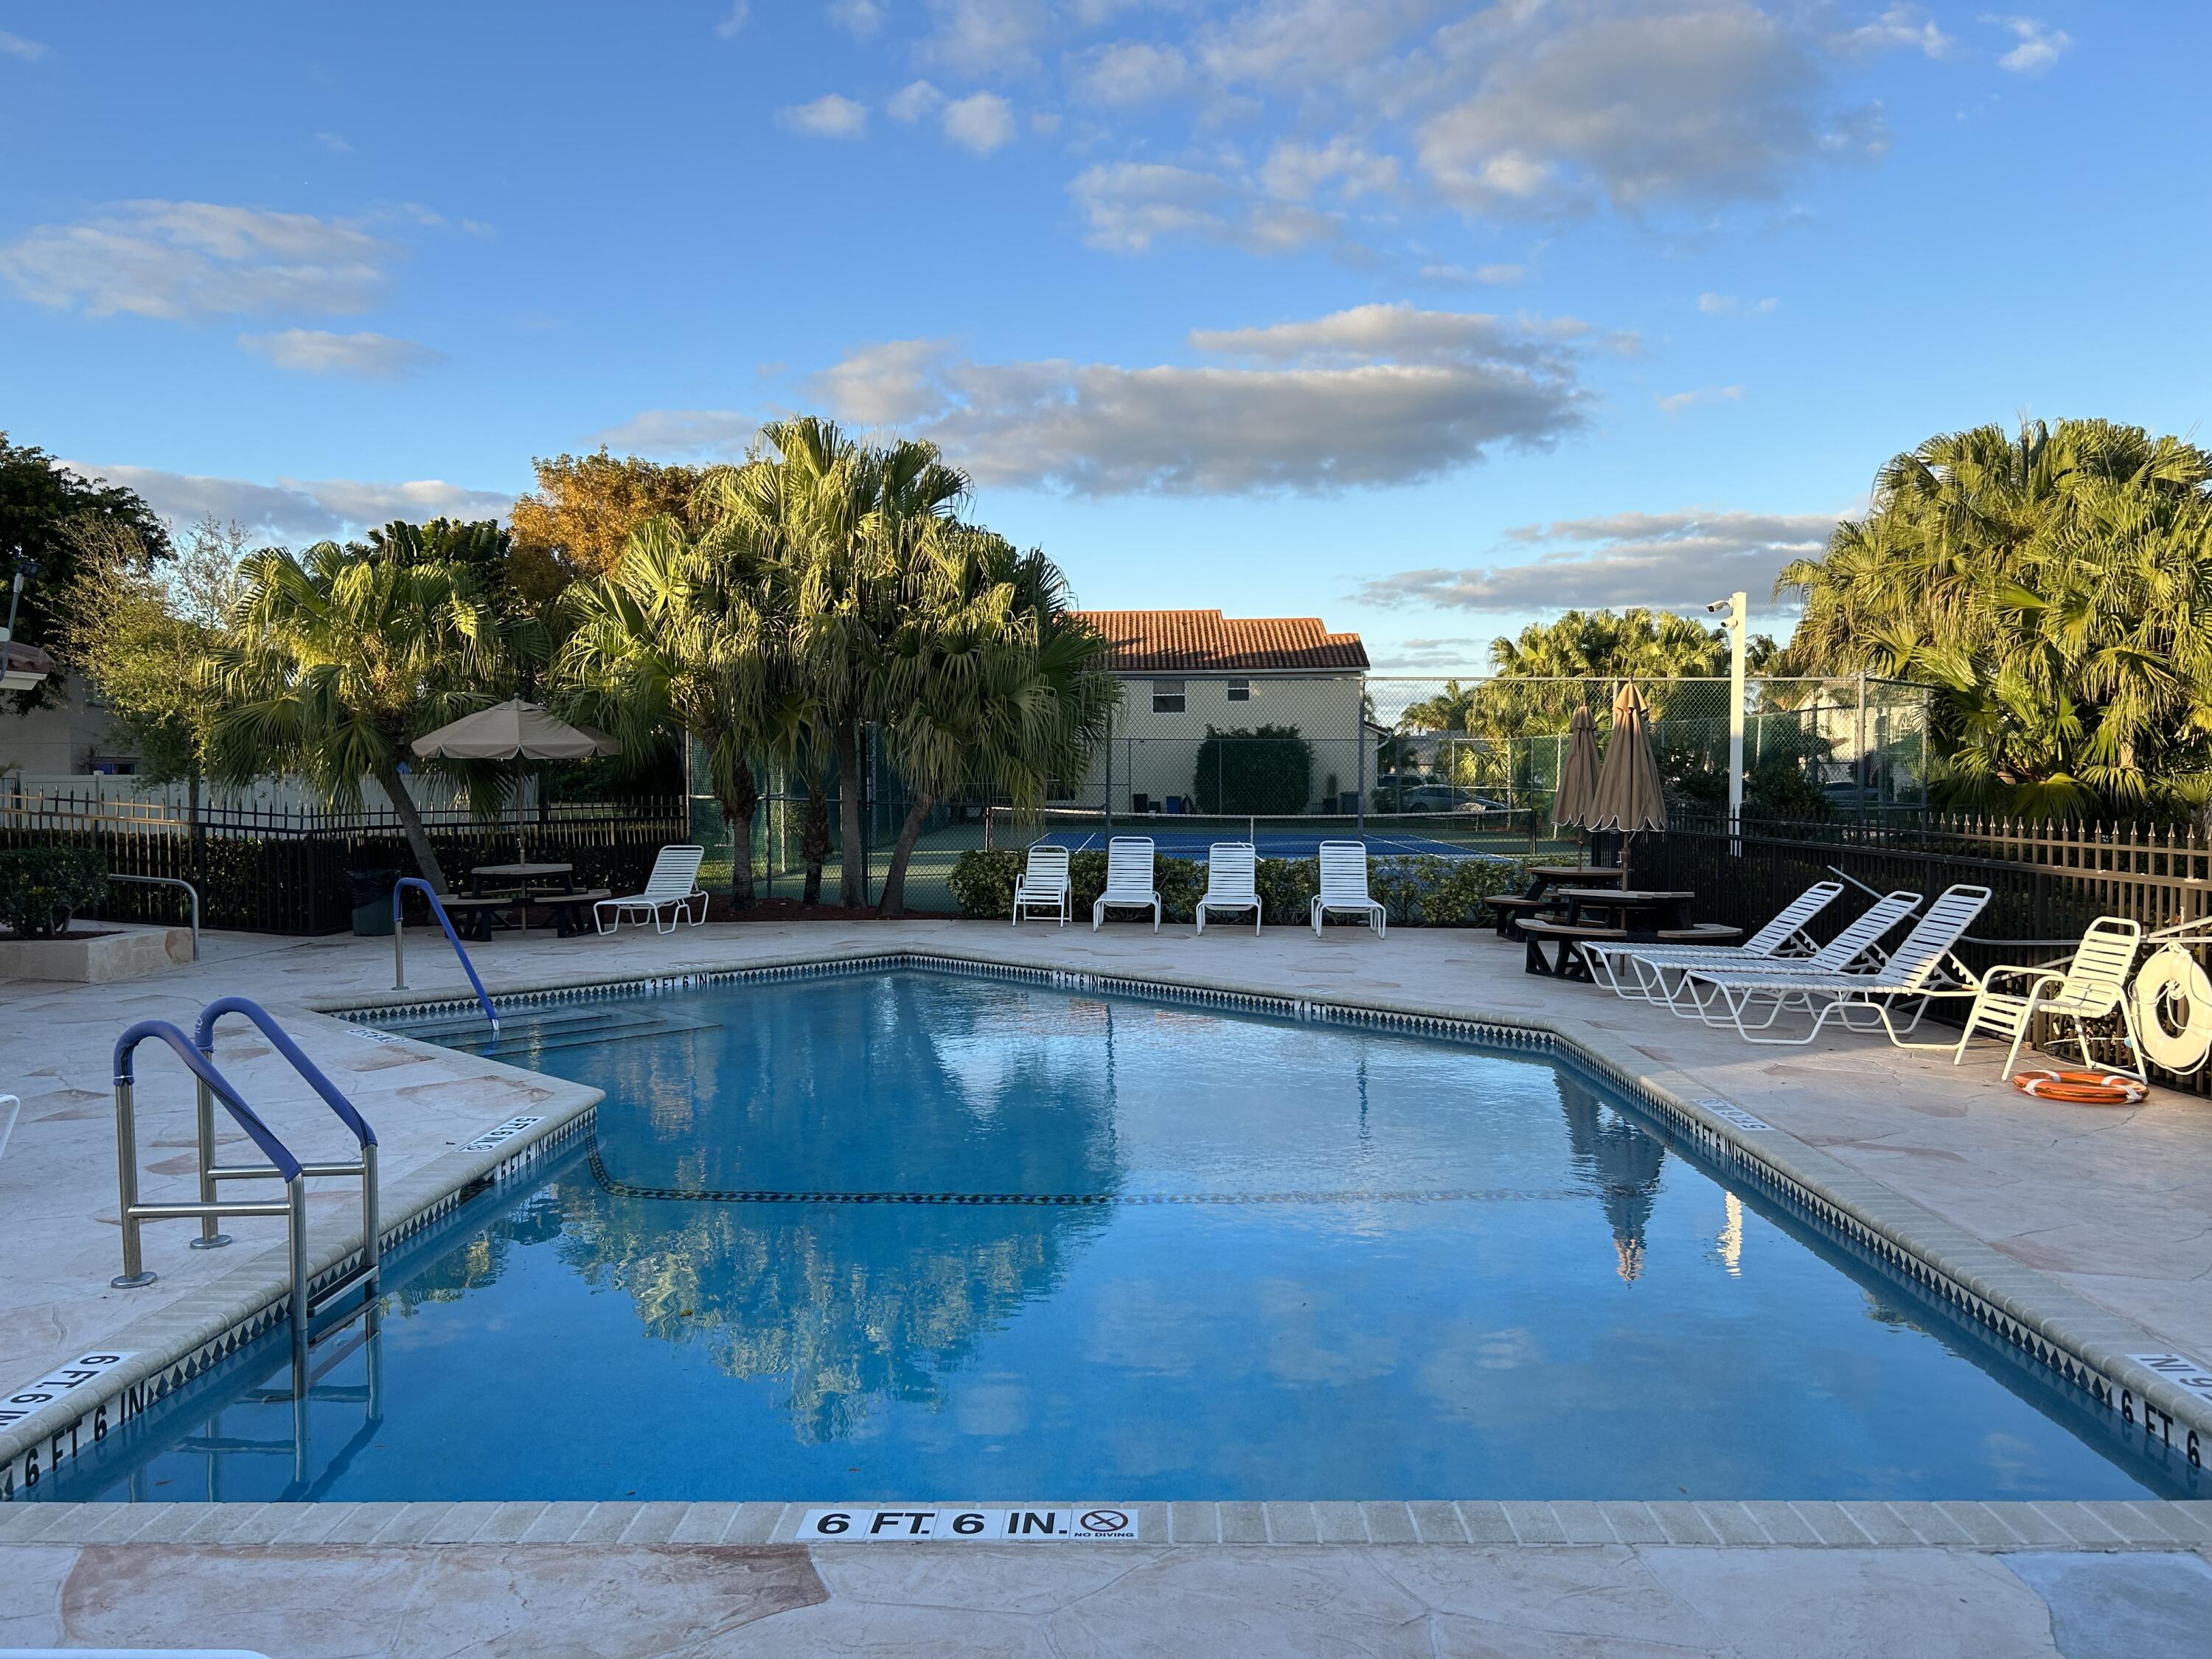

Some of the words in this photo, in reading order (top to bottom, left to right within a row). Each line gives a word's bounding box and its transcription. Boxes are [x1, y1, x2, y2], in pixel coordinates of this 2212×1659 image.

[663, 977, 677, 989] FT
[683, 975, 689, 985] 6
[695, 974, 707, 984] IN
[1089, 975, 1098, 985] IN
[1311, 1003, 1325, 1015] FT
[510, 1150, 521, 1175] FT
[535, 1135, 545, 1158] IN
[1725, 1137, 1734, 1161] IN
[80, 1355, 120, 1364] 6
[10, 1394, 54, 1403] 6
[25, 1447, 40, 1487] 6
[52, 1418, 83, 1471] FT
[94, 1405, 108, 1441] 6
[119, 1380, 145, 1426] IN
[2121, 1388, 2135, 1424] 6
[2145, 1401, 2174, 1449] FT
[2187, 1430, 2201, 1468] 6
[817, 1513, 852, 1534] 6
[870, 1512, 936, 1534] FT.
[952, 1513, 985, 1534] 6
[1007, 1512, 1068, 1534] IN.
